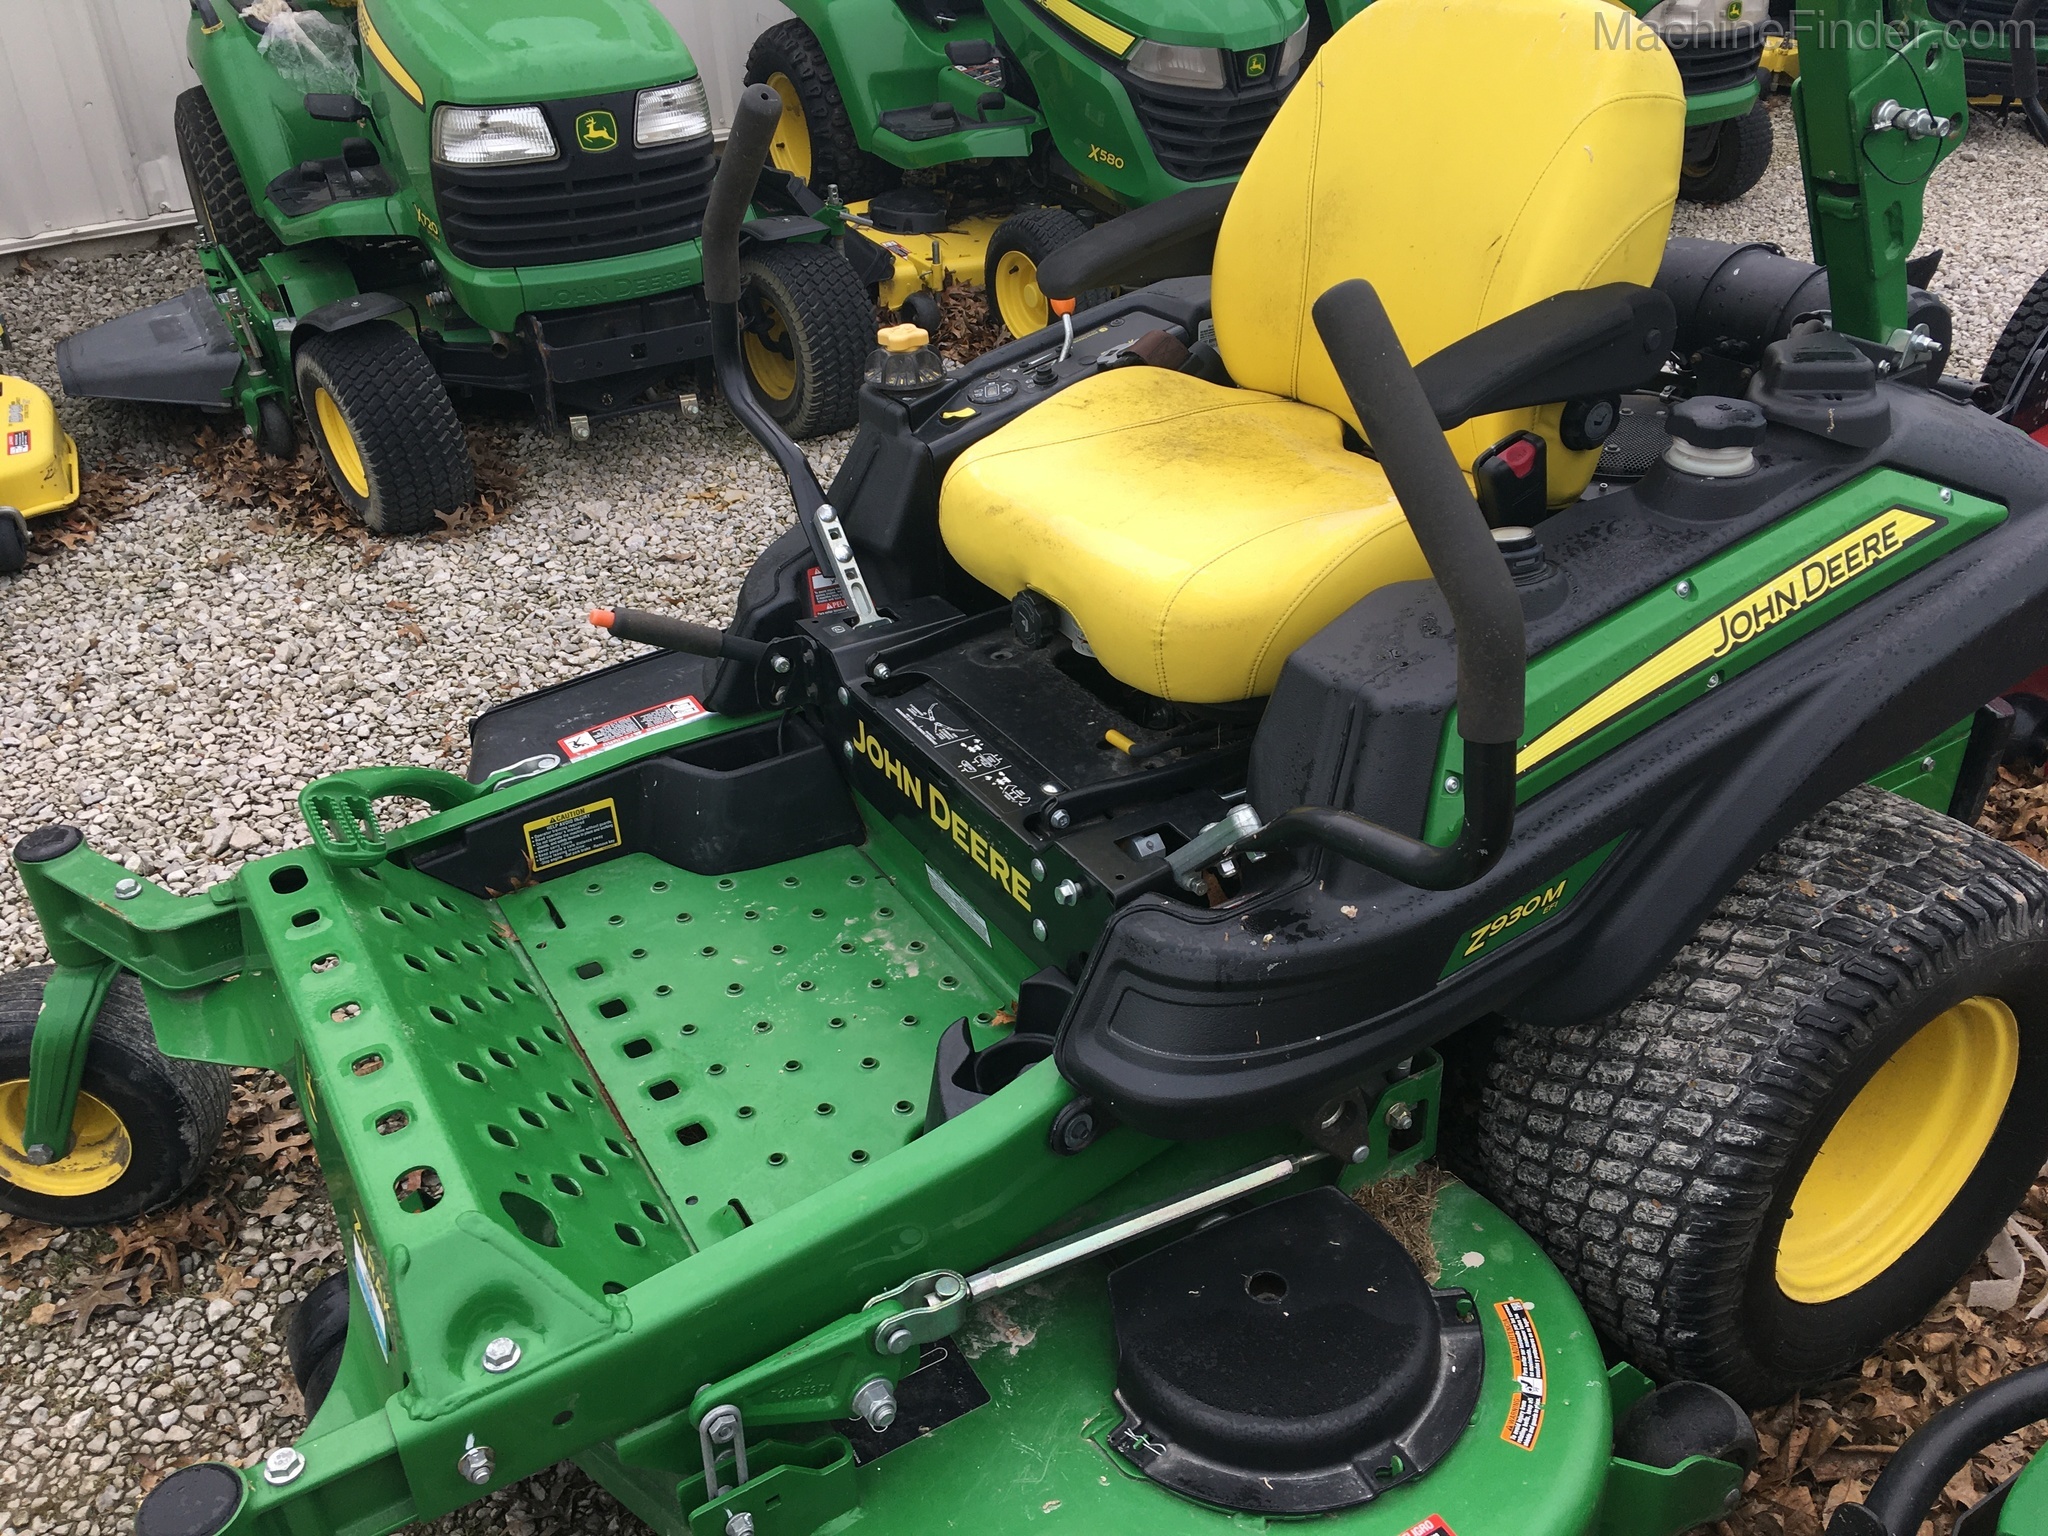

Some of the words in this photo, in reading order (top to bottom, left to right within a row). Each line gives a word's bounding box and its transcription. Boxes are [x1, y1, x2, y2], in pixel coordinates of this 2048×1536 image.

[1088, 144, 1124, 169] X580
[540, 284, 608, 308] JOHN
[616, 269, 692, 298] DEERE
[1713, 580, 1799, 655] JOHN
[1801, 519, 1900, 599] DEERE
[556, 807, 585, 821] CAUTION
[853, 719, 923, 809] JOHN
[928, 782, 1031, 913] DEERE
[1463, 879, 1567, 957] Z930M
[1542, 900, 1560, 915] EFI
[1508, 1398, 1520, 1428] WARNING
